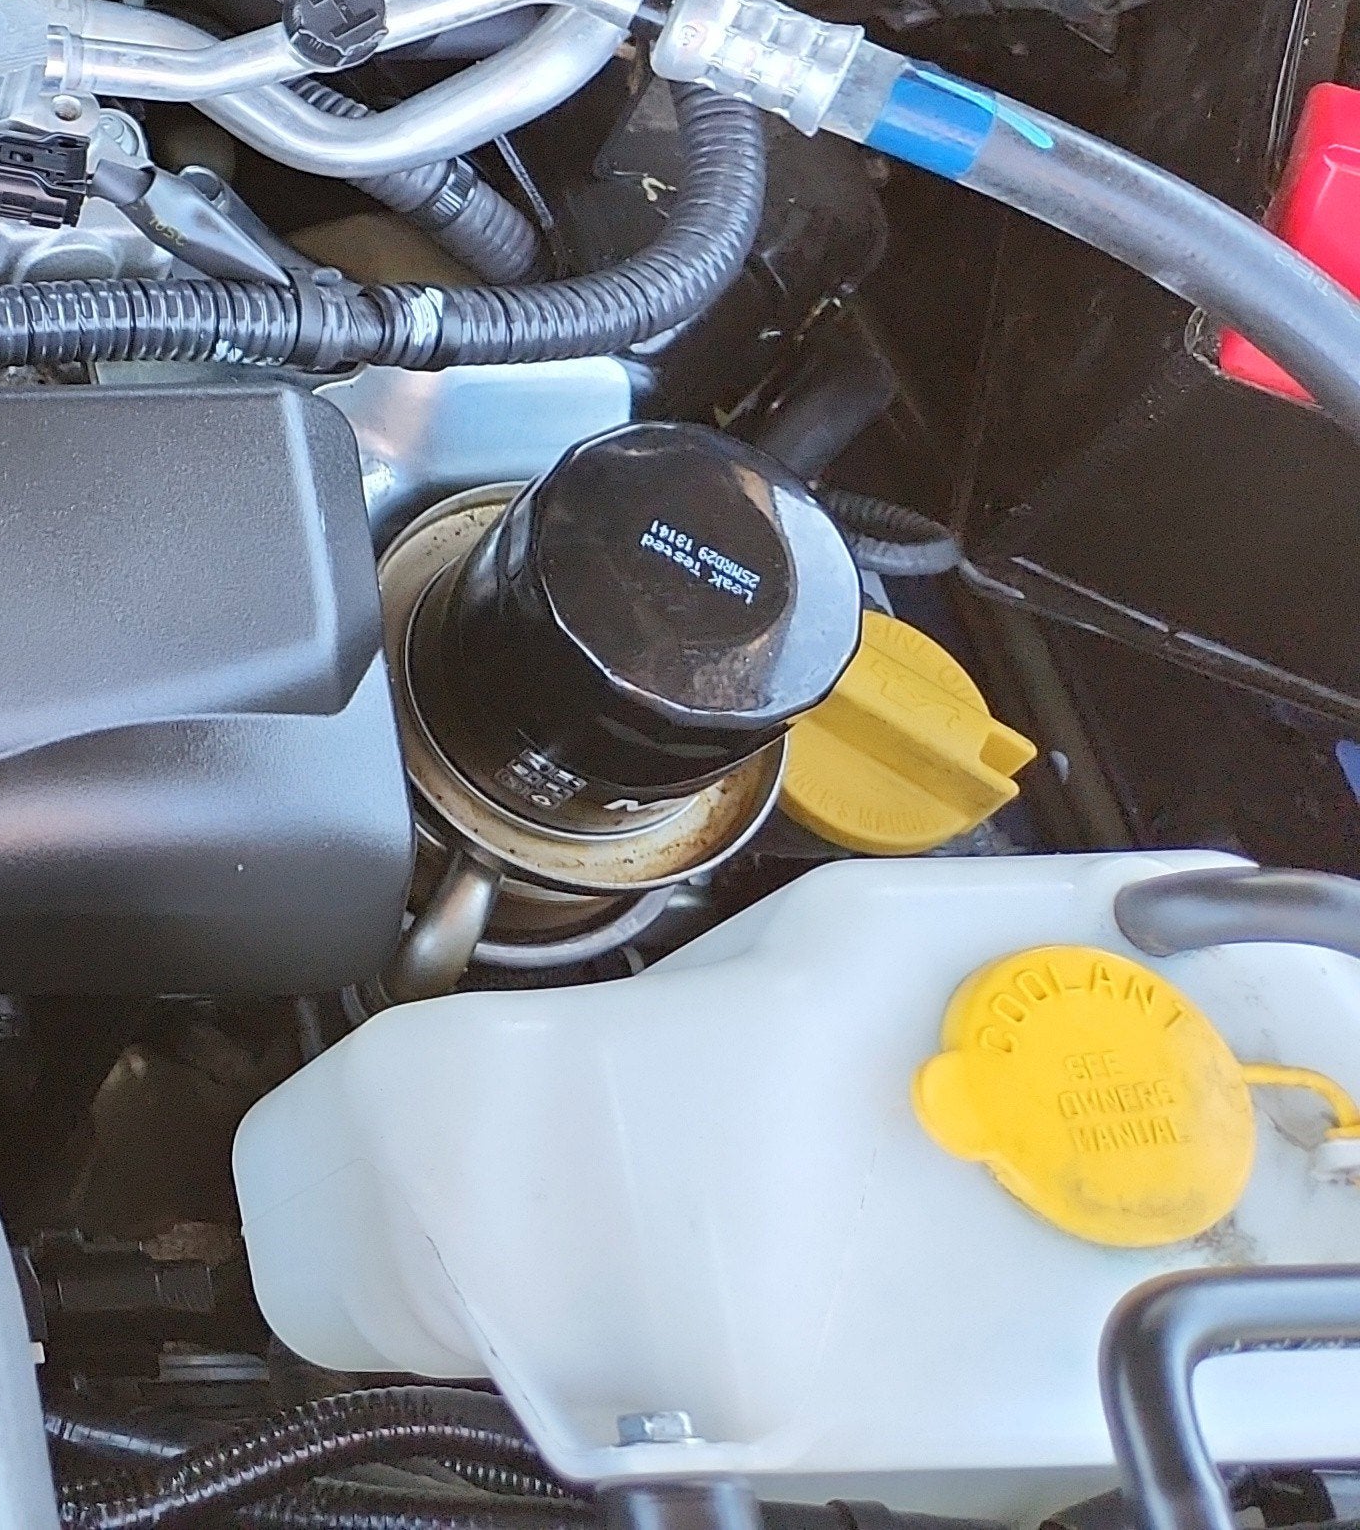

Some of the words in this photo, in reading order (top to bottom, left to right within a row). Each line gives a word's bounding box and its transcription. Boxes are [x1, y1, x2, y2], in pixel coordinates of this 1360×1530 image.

[639, 533, 701, 577] Tested
[650, 519, 693, 551] 13141
[708, 571, 753, 605] Leak
[977, 958, 1196, 1055] COOLANT
[1063, 1051, 1122, 1081] SEE
[1058, 1079, 1176, 1119] OWNERS
[1069, 1115, 1185, 1155] MANUAL
